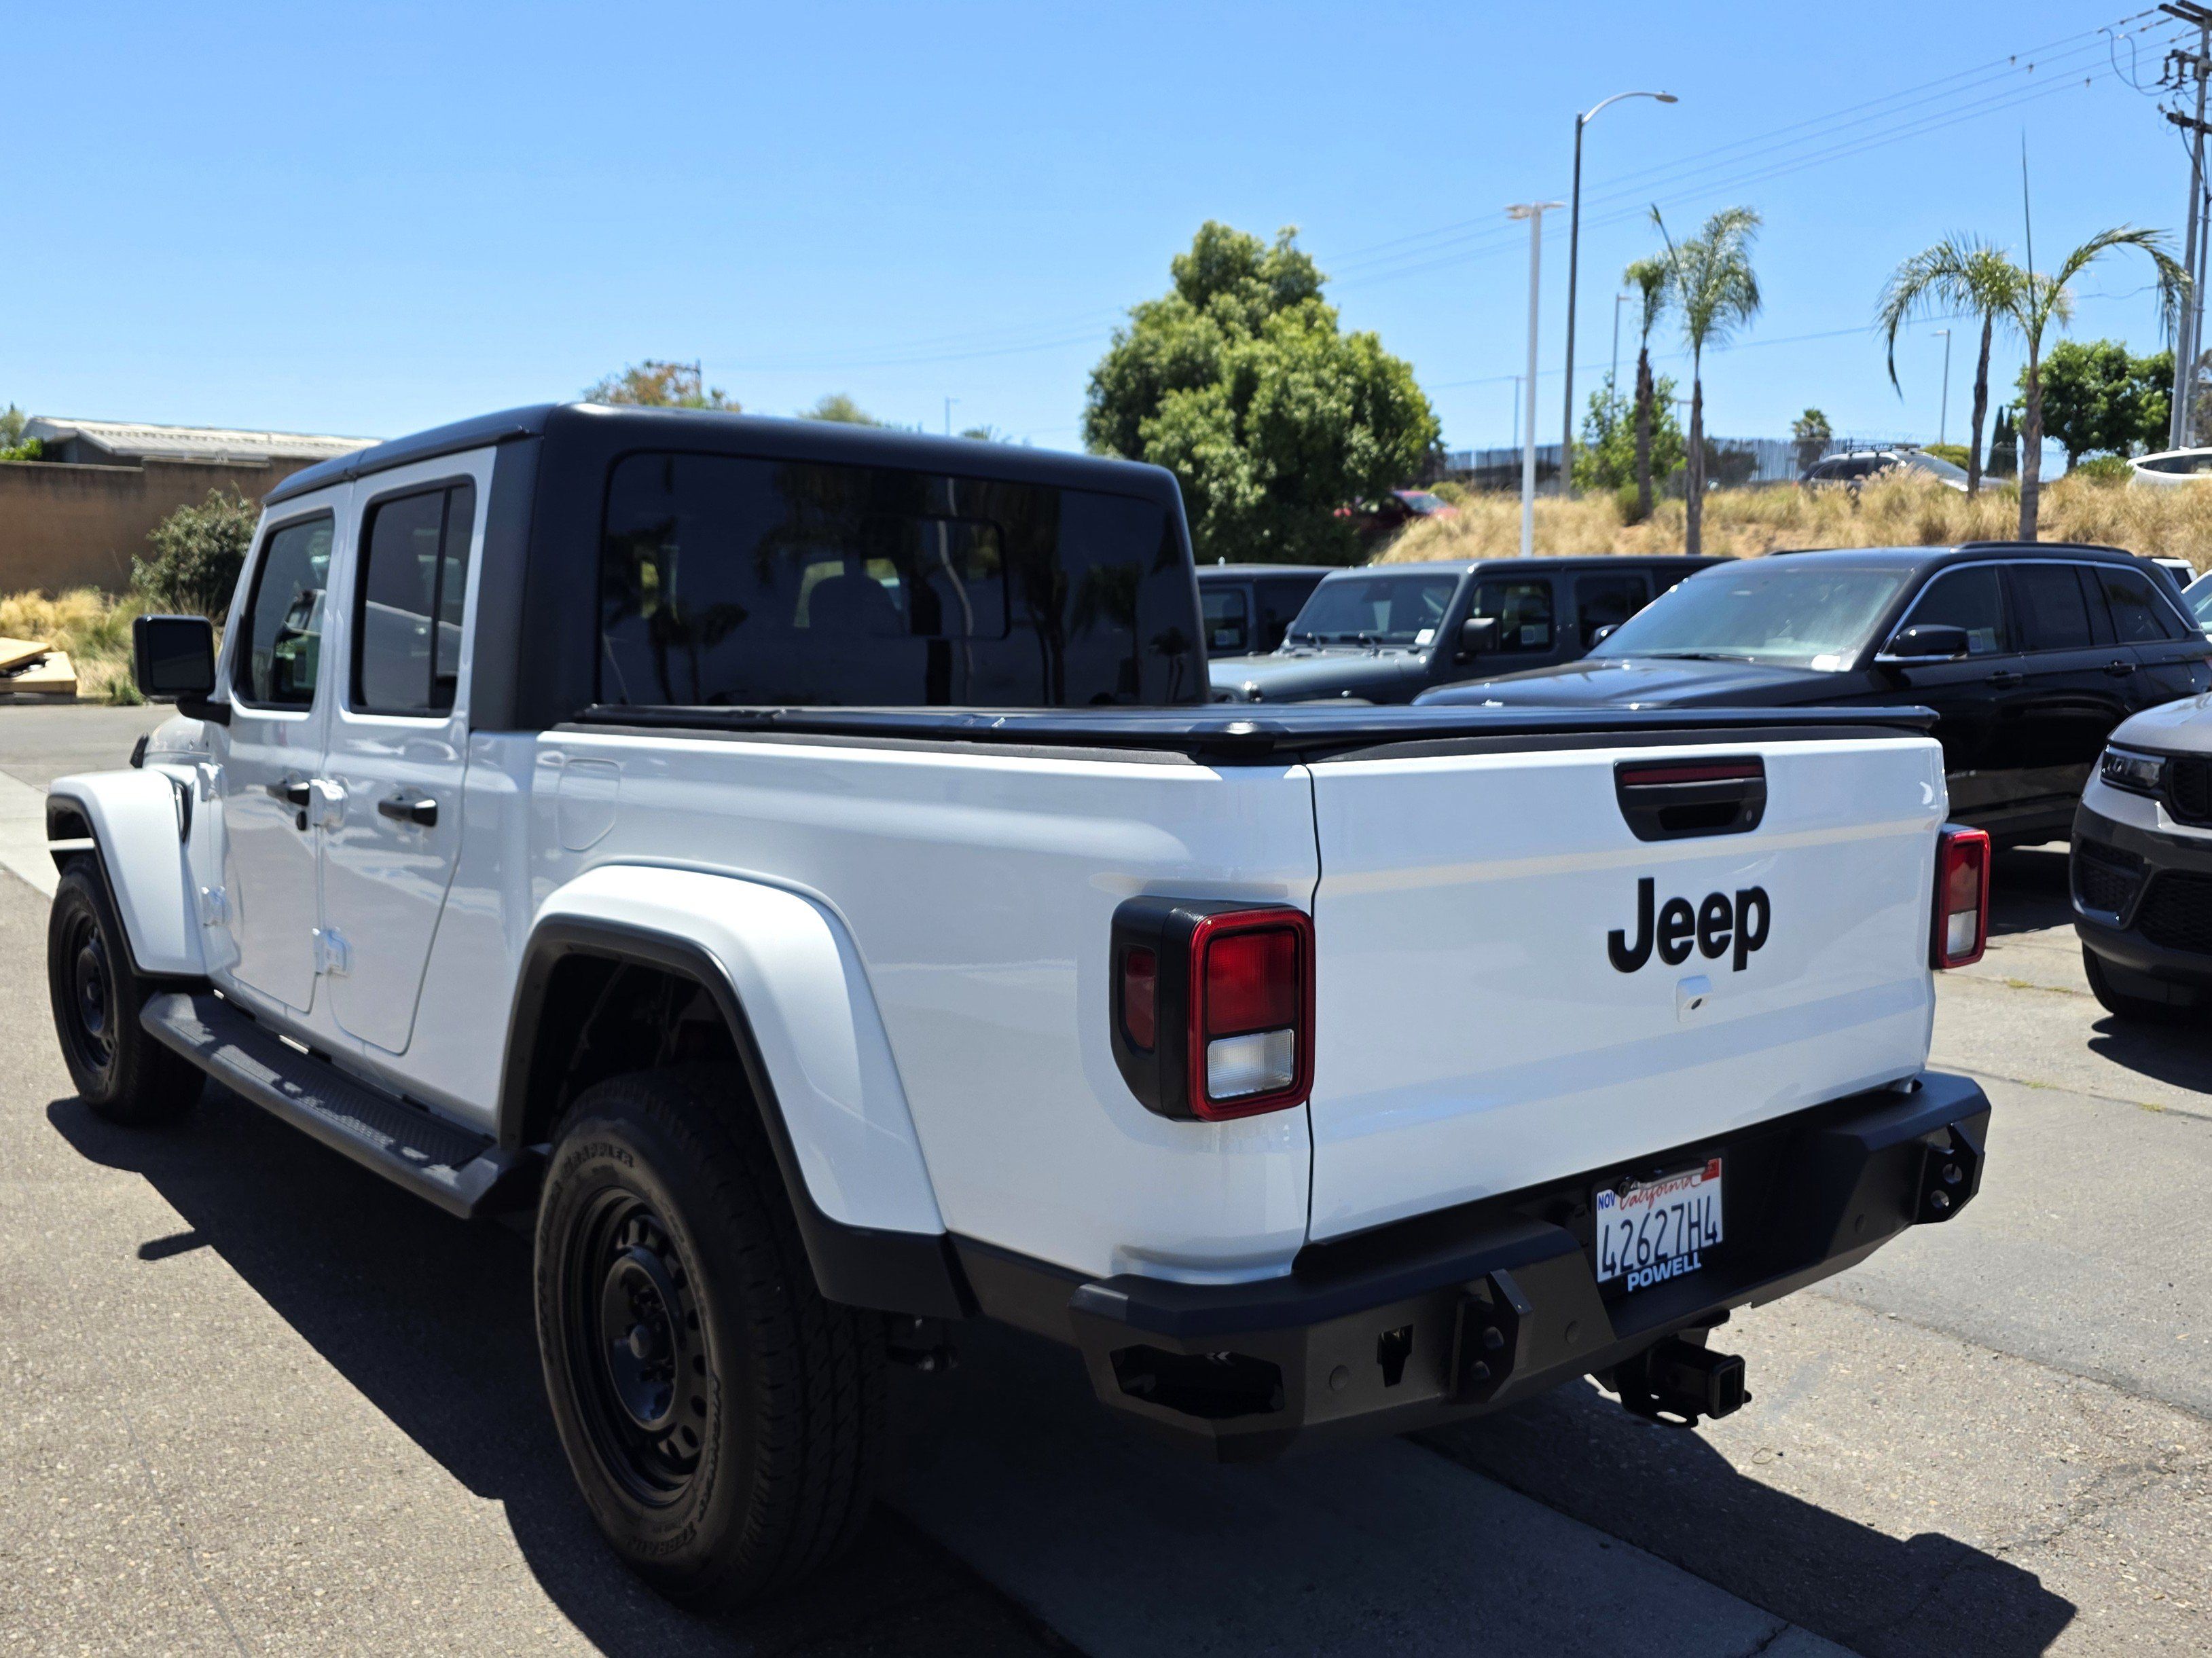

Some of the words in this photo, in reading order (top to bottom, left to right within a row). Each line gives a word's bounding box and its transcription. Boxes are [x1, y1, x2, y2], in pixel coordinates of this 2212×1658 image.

[1608, 877, 1771, 973] Jeep
[1598, 1191, 1616, 1211] NOV
[1602, 1195, 1718, 1276] 42627H4
[1627, 1251, 1702, 1292] POWELL
